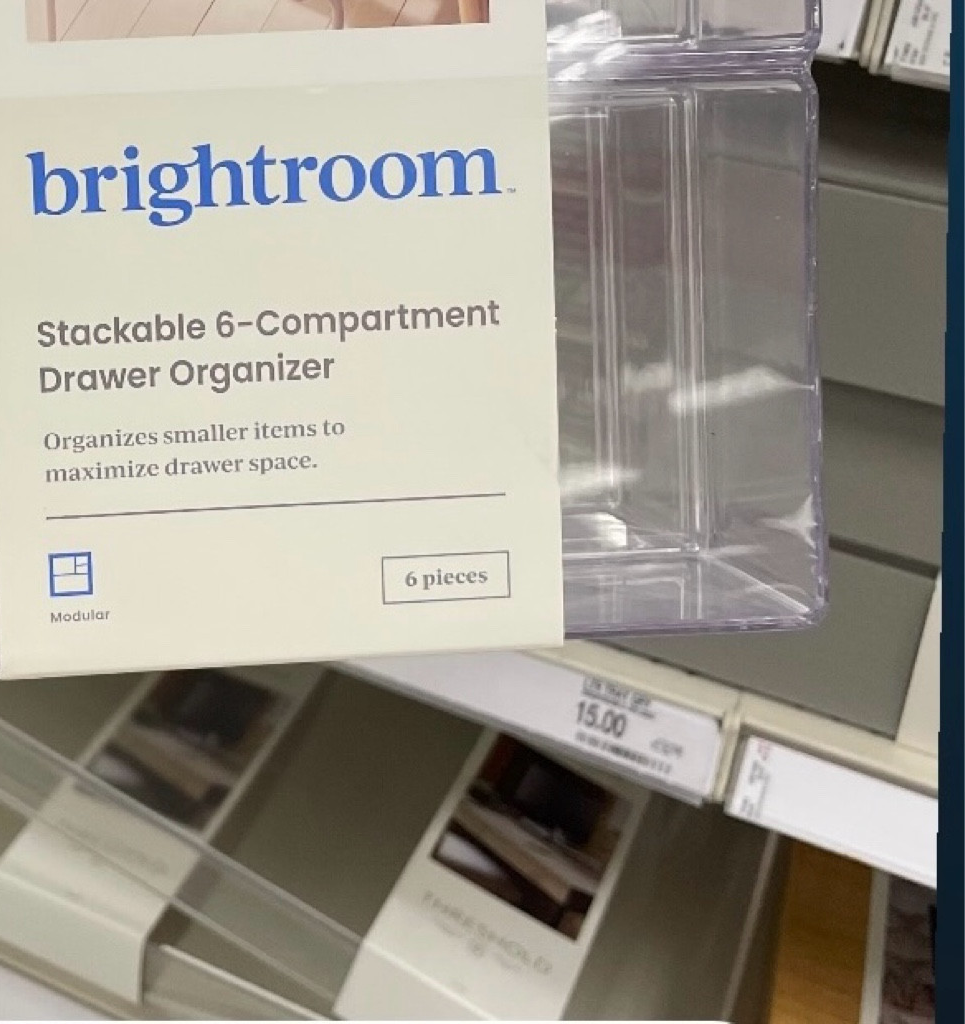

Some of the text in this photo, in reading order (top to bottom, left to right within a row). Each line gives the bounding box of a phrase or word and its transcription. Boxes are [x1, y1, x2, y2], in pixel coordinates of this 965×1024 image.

[25, 142, 502, 227] brightroom
[37, 299, 501, 348] Stackable 6-Compartment
[39, 352, 335, 394] Drawer Organizer
[43, 419, 346, 453] Organizes smaller items to
[45, 453, 318, 484] maximize drawer space.
[404, 567, 489, 592] 6 pieces
[49, 607, 111, 624] Modular
[576, 700, 627, 738] 15.00
